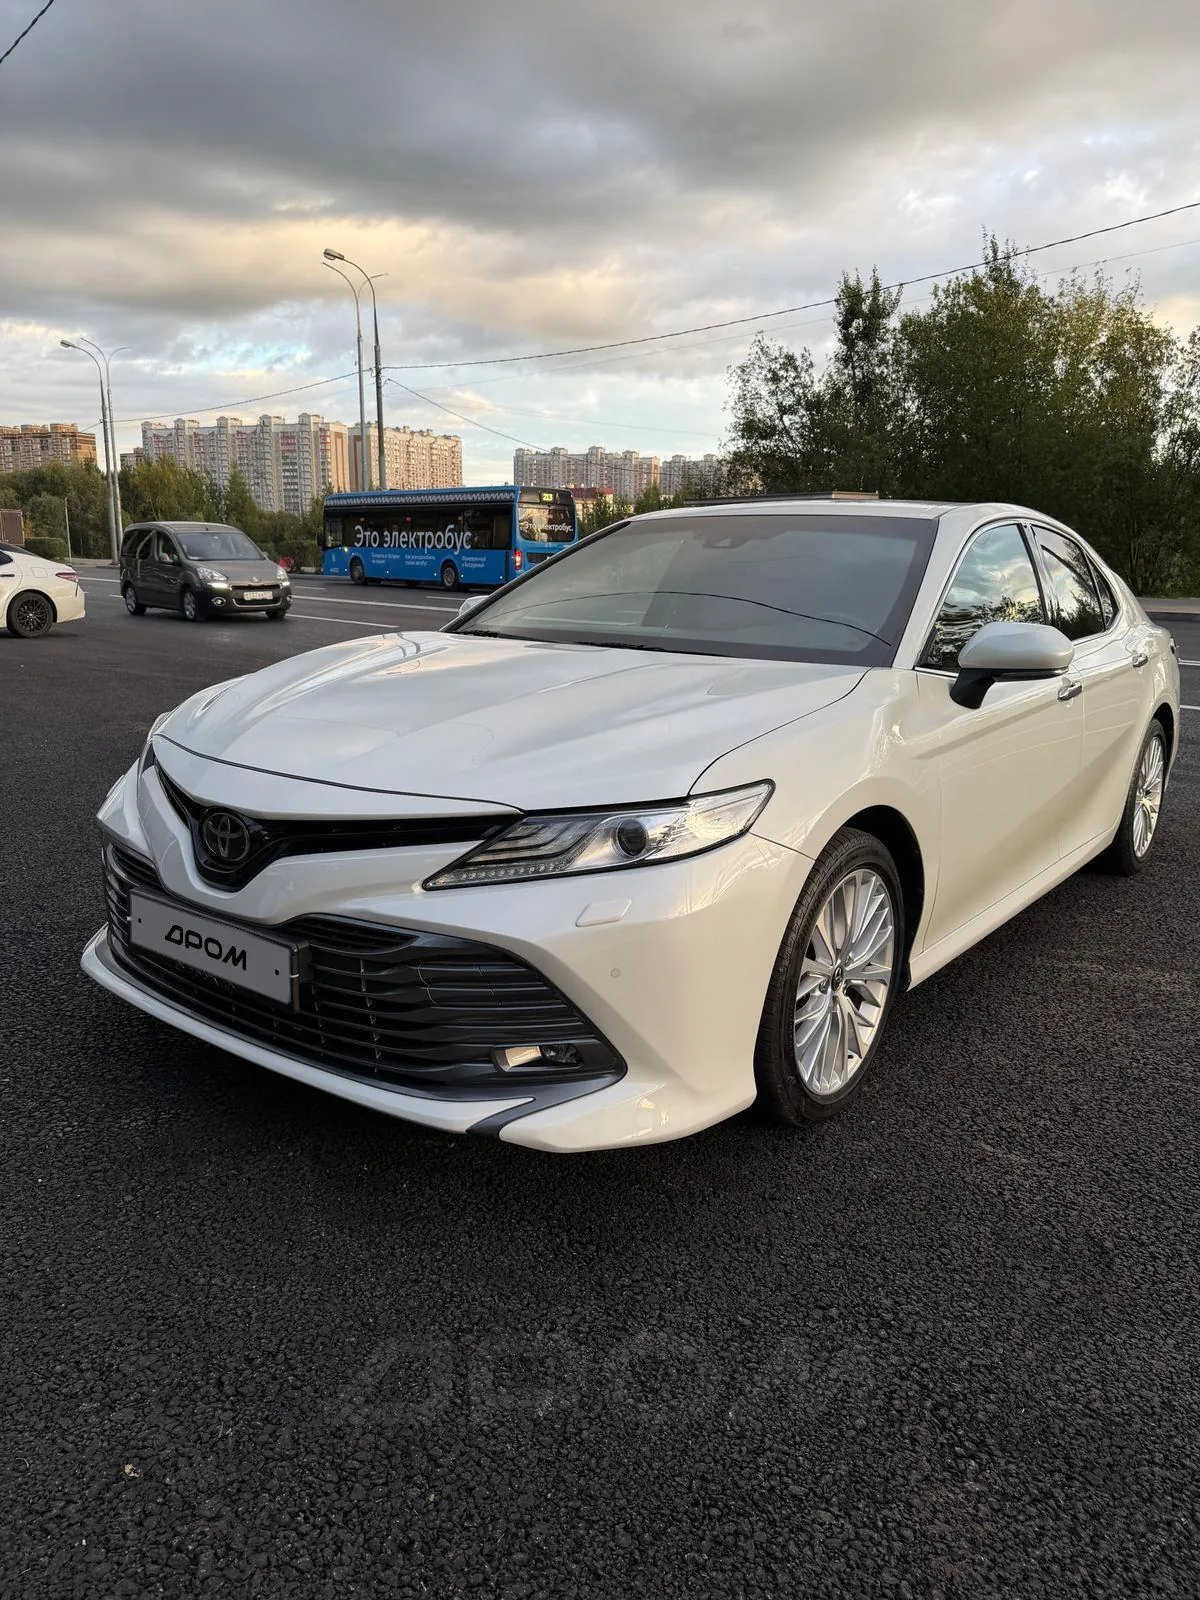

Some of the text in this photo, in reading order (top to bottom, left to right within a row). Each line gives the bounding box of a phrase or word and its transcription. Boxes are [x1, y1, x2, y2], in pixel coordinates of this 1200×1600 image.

[542, 493, 553, 501] 213
[538, 522, 573, 532] ектробус.
[354, 524, 472, 555] Это электробус
